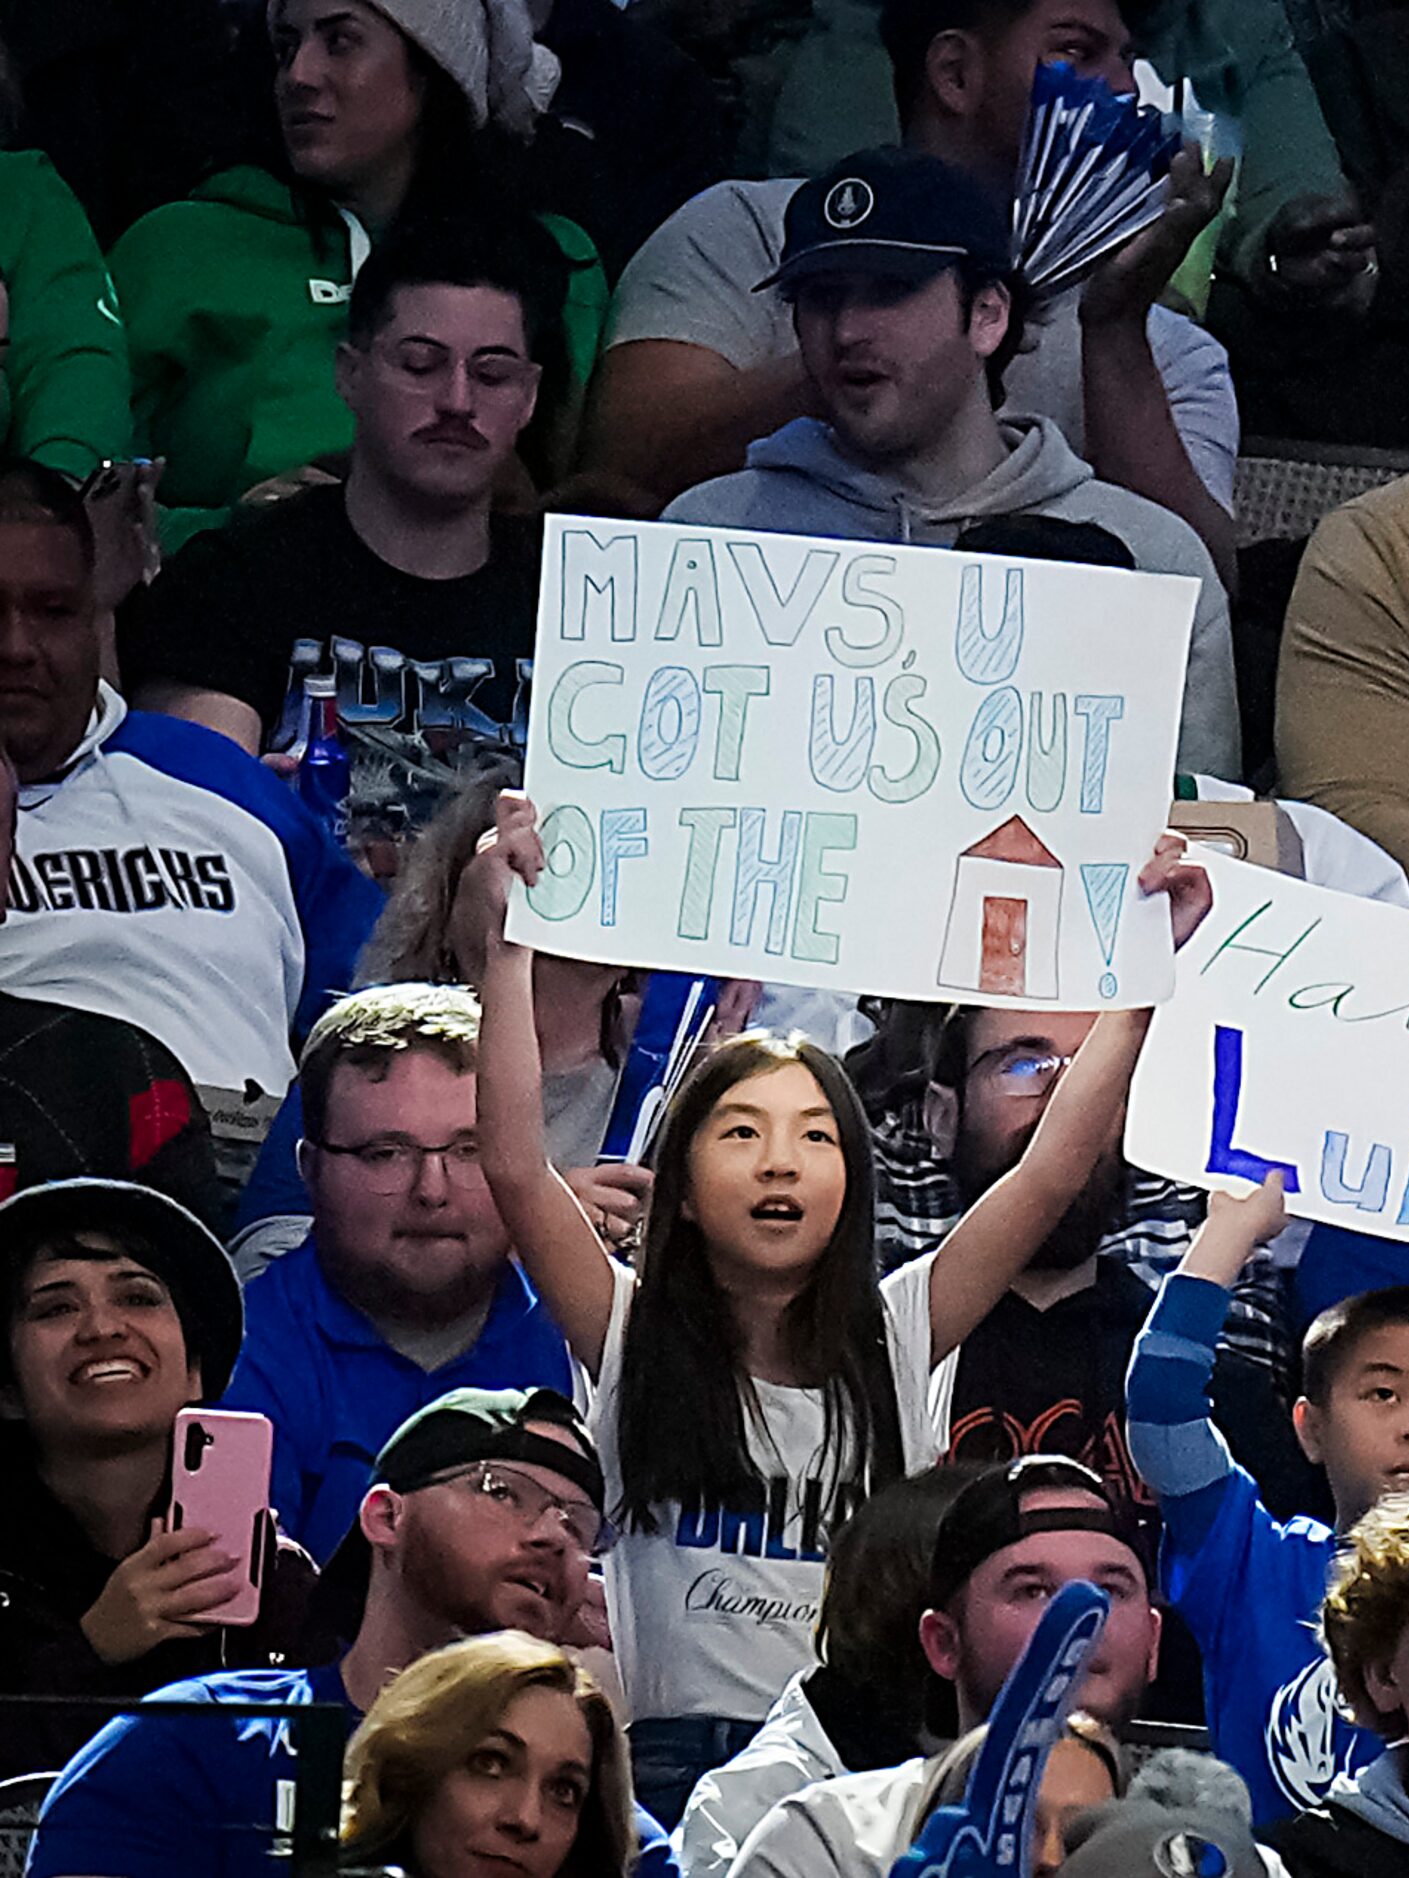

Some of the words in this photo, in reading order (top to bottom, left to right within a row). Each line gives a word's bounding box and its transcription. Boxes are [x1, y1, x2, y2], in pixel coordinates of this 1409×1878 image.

[560, 530, 917, 670] MAVS,
[955, 563, 1025, 685] U
[547, 660, 771, 782] GOT
[808, 673, 941, 804] US
[959, 685, 1124, 813] OUT
[526, 804, 648, 927] OF
[677, 807, 858, 965] THE
